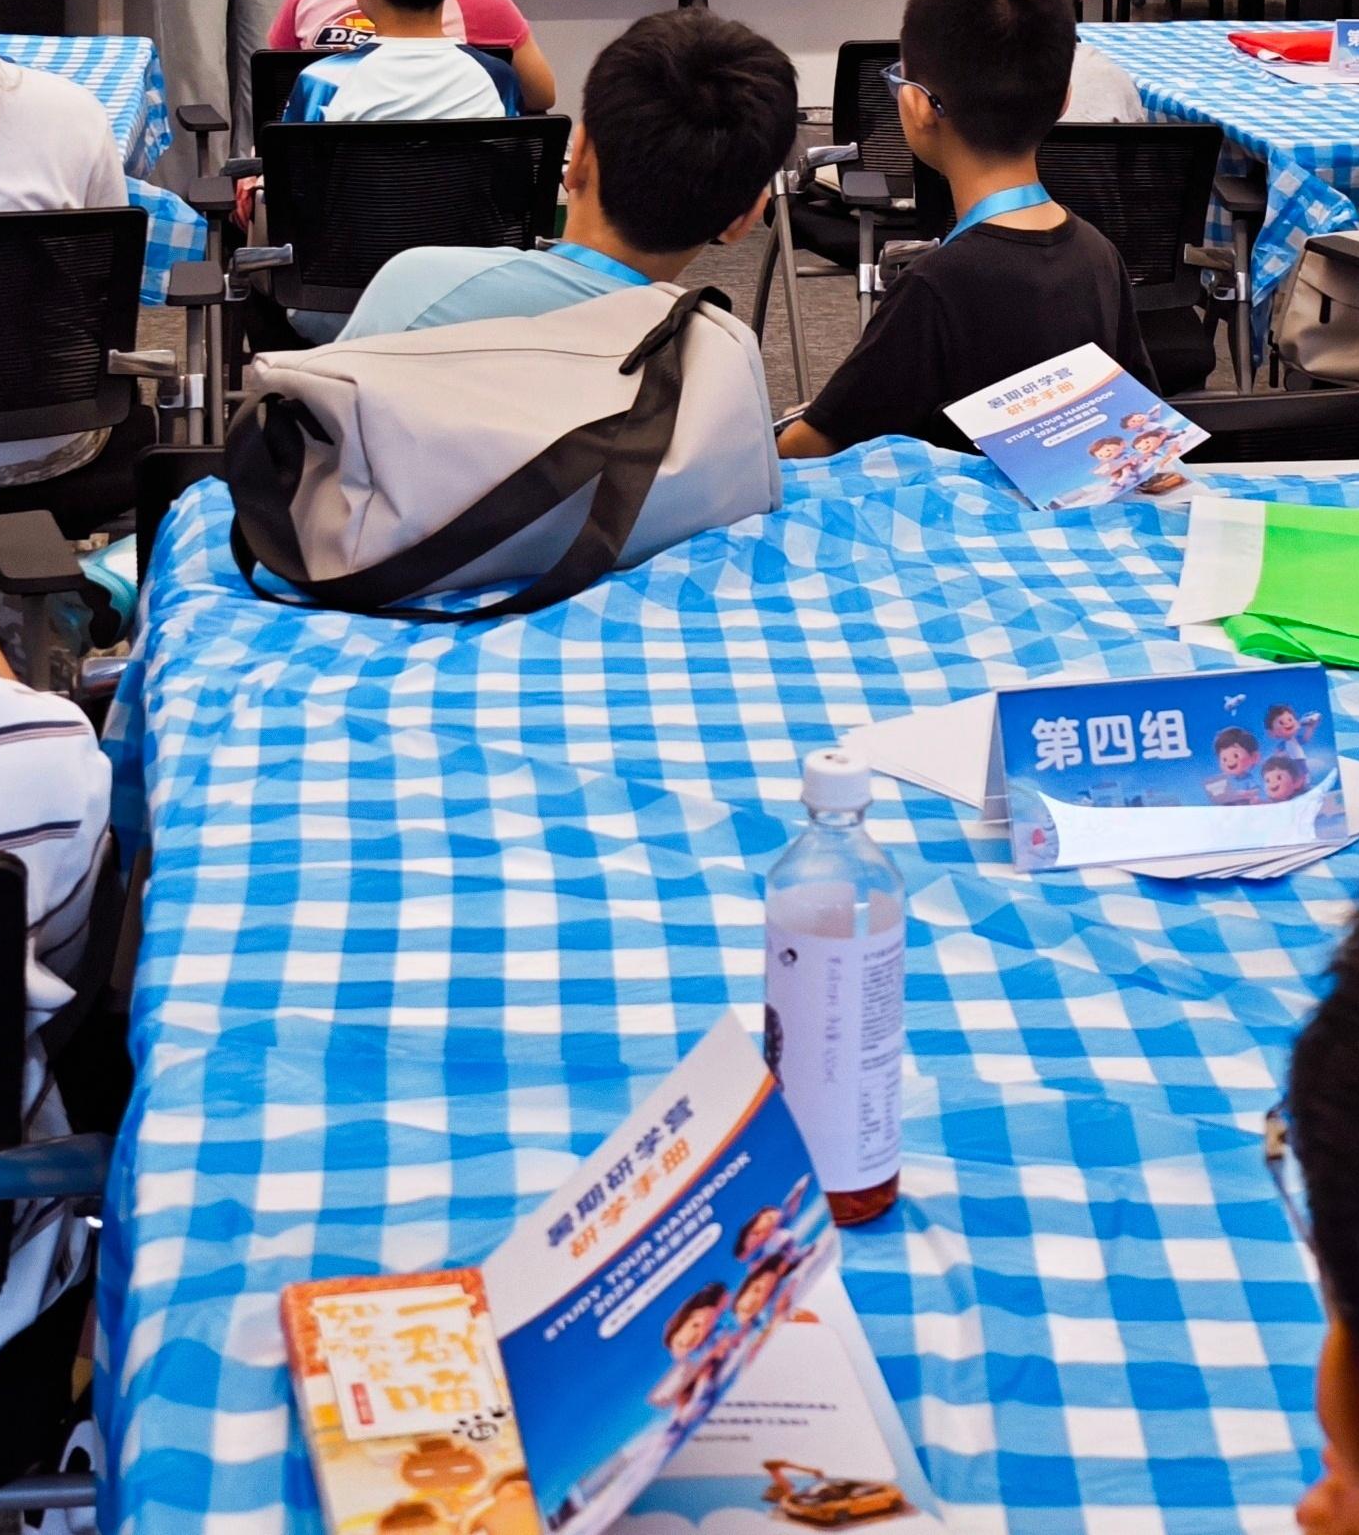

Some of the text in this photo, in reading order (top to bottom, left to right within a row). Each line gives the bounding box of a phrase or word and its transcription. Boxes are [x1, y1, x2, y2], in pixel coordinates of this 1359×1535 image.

[987, 367, 1074, 411] 暑期研学营
[1005, 425, 1036, 445] STUDY
[1036, 414, 1064, 429] TOUR
[1063, 390, 1116, 418] HANDBOOK
[1006, 380, 1075, 417] 研学手册
[1031, 708, 1193, 771] 第四组
[547, 1094, 694, 1247] 暑期研学营
[570, 1137, 691, 1258] 研学手册
[543, 1285, 603, 1342] STUDY
[604, 1240, 654, 1286] TOUR
[652, 1150, 753, 1243] HANDBOOK
